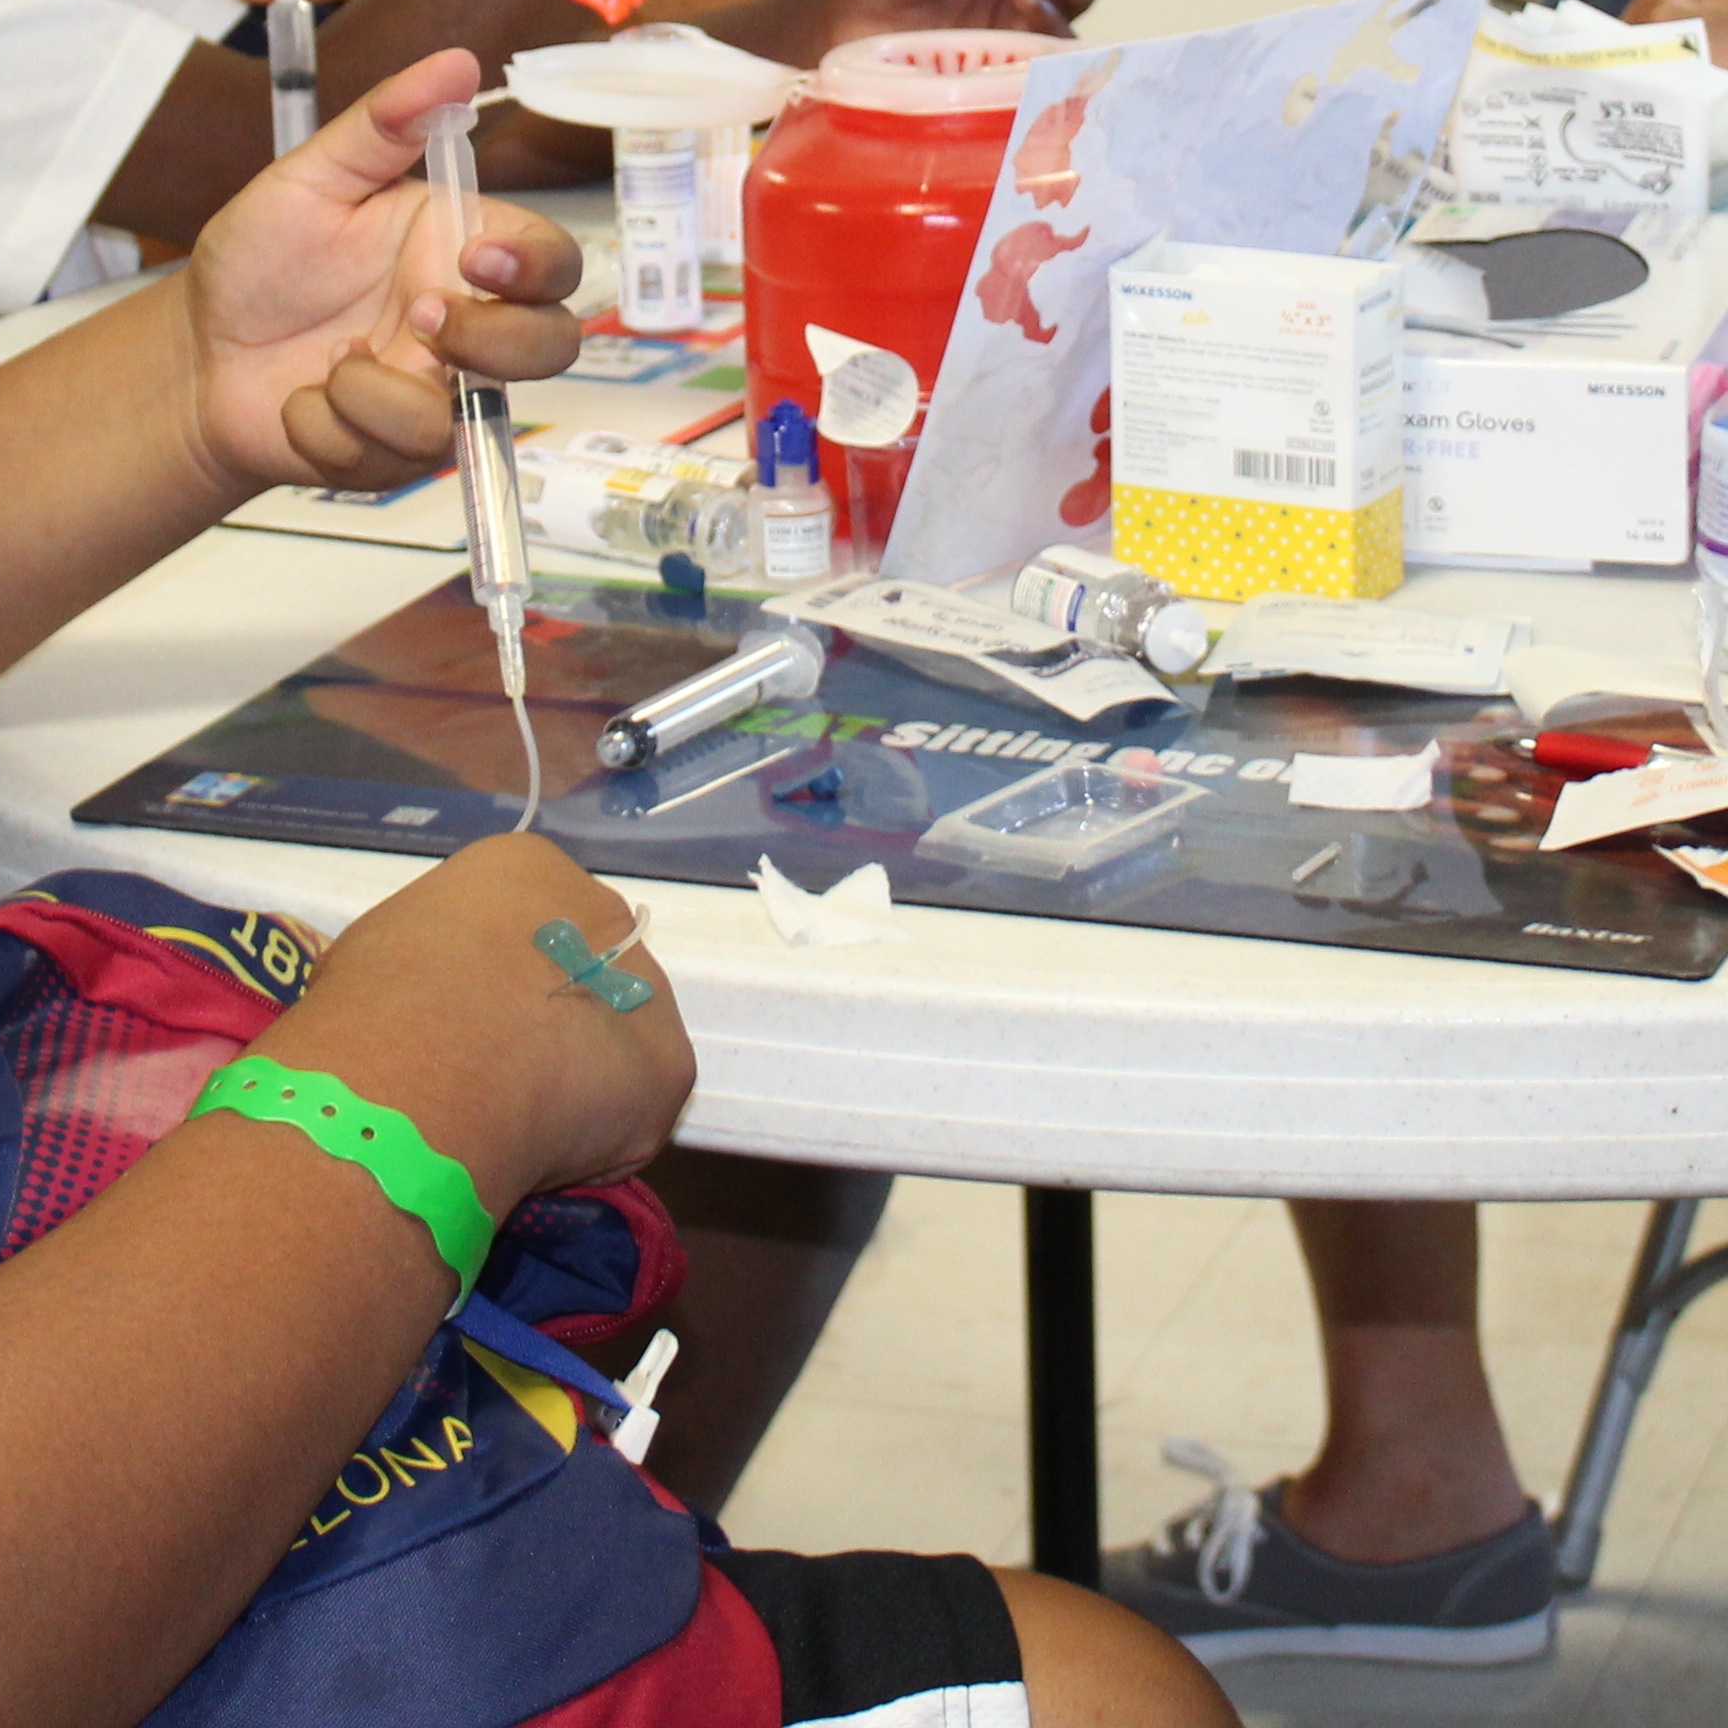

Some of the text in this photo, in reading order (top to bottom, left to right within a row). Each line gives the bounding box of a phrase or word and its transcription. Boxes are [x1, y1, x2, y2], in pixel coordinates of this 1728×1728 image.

[1456, 409, 1536, 433] Gloves
[229, 911, 313, 997] 18
[1522, 922, 1654, 944] Baxter
[291, 1416, 474, 1550] LONA
